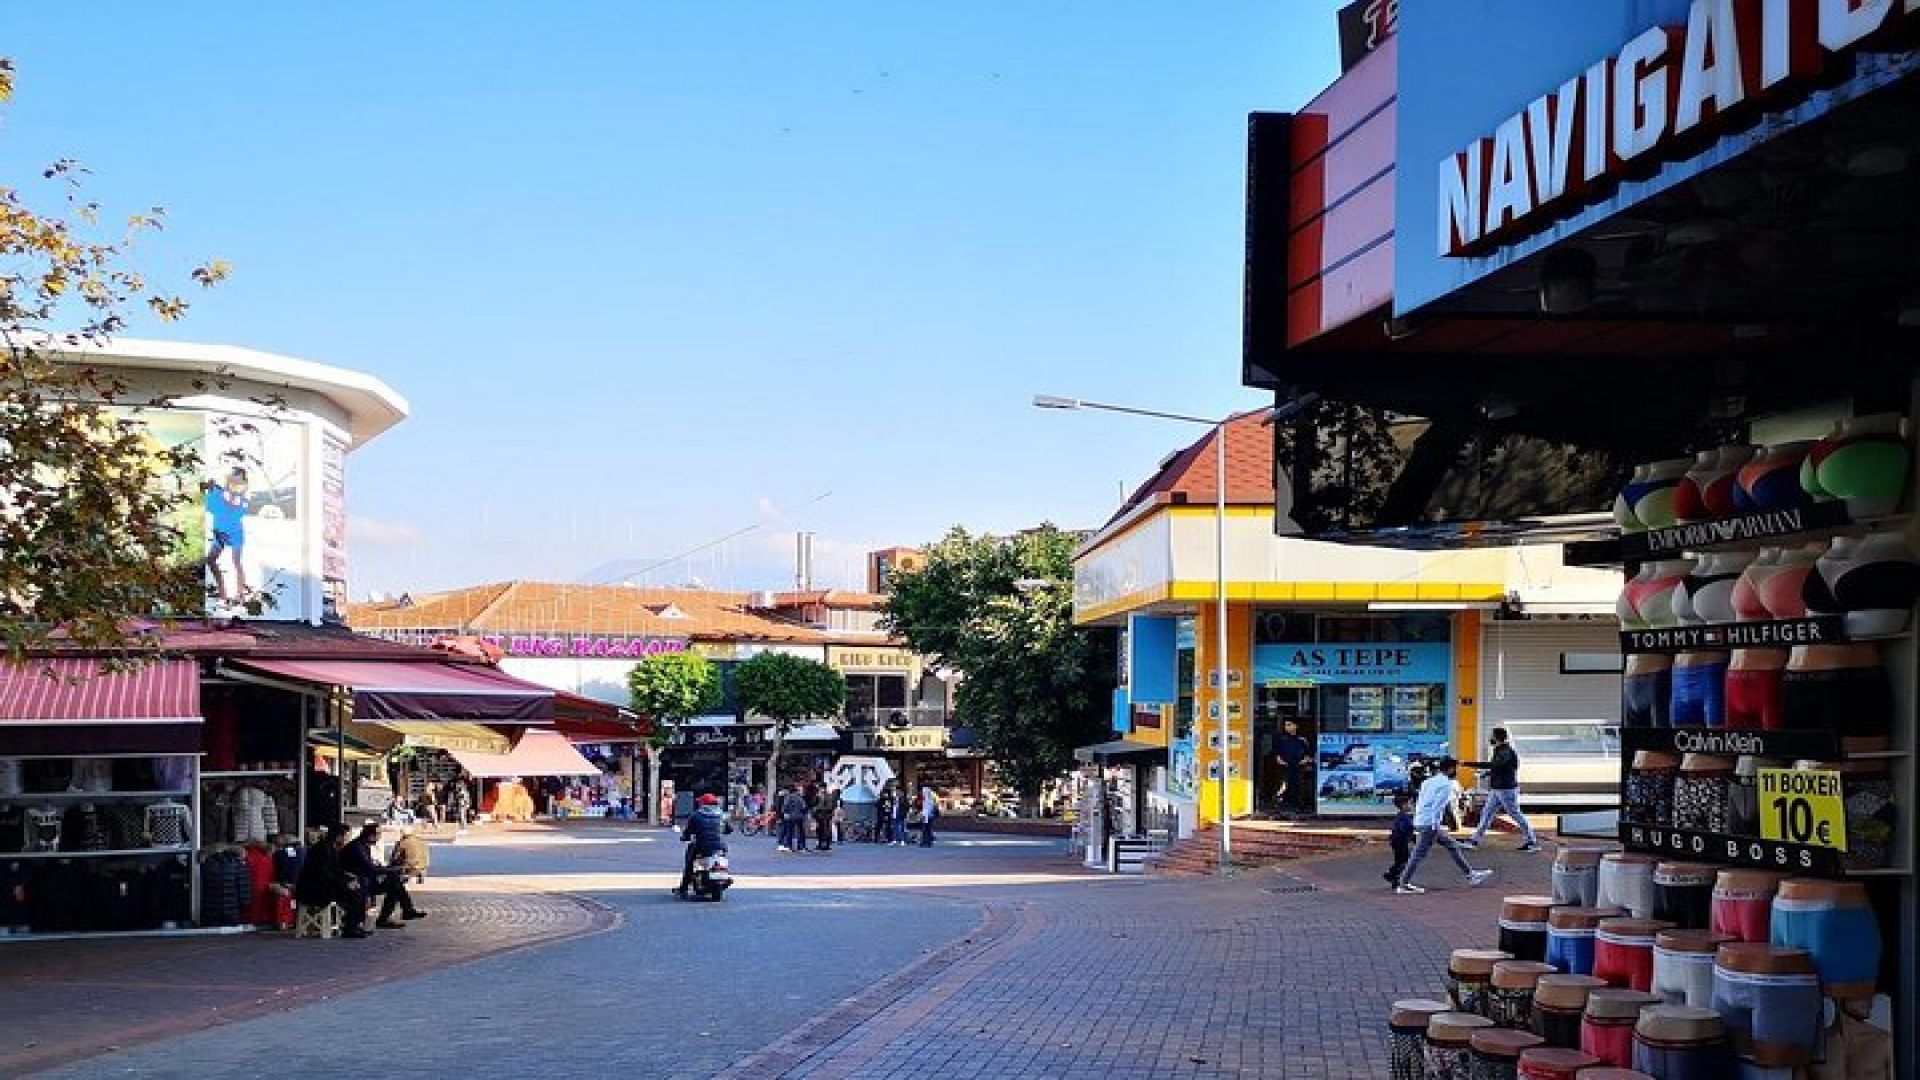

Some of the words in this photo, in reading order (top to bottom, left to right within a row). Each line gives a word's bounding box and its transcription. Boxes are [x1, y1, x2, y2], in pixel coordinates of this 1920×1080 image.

[1631, 629, 1700, 649] TOMMY
[1727, 622, 1823, 644] HILFIGER
[1290, 649, 1327, 666] AS
[1335, 649, 1412, 666] TEPE
[1674, 730, 1723, 752] Calvin
[1725, 732, 1764, 754] Klein
[1780, 774, 1839, 797] BOXER
[1631, 829, 1705, 853] HUGO
[1727, 840, 1812, 867] BOSS
